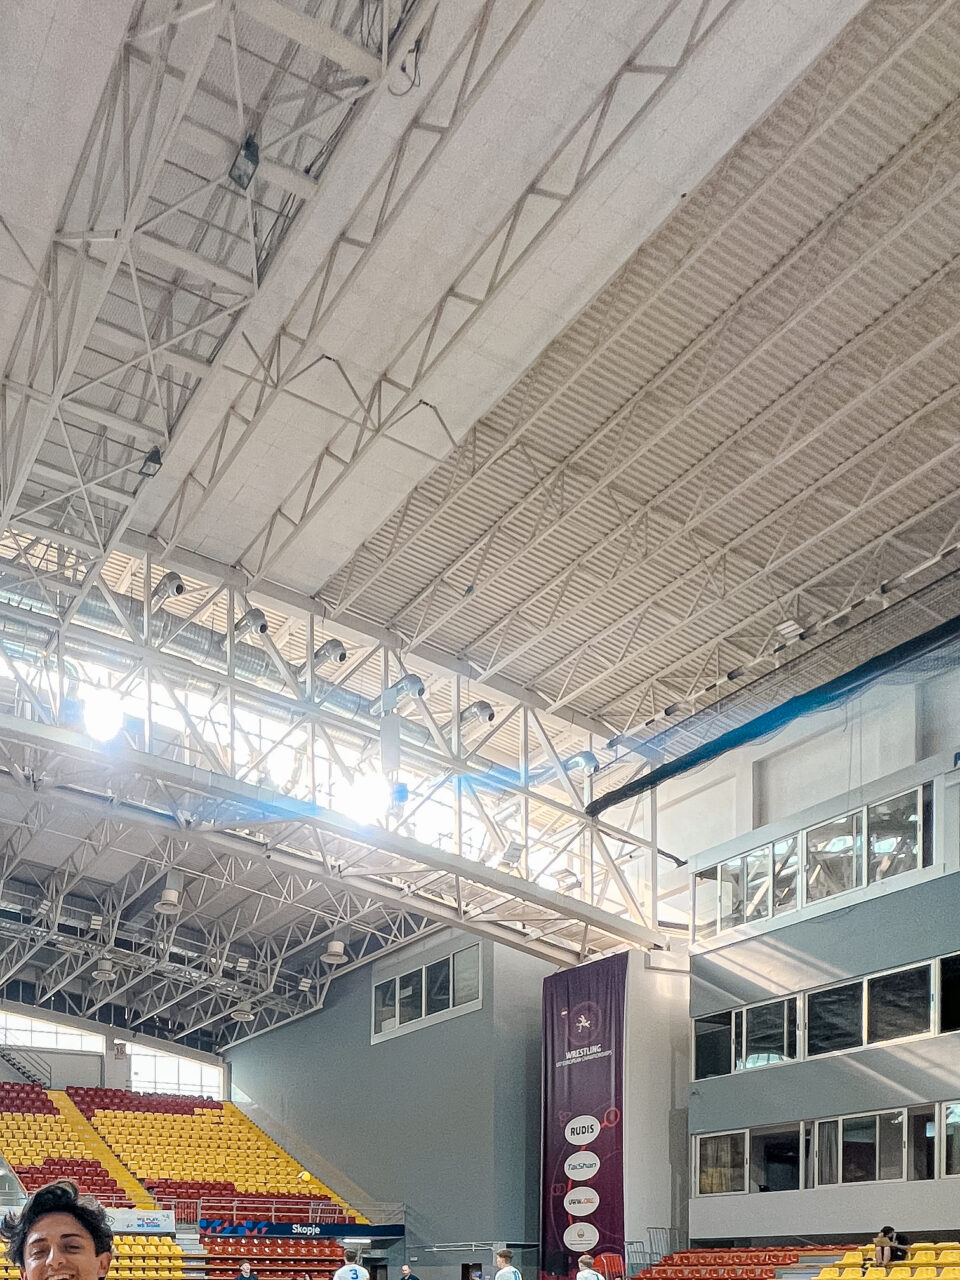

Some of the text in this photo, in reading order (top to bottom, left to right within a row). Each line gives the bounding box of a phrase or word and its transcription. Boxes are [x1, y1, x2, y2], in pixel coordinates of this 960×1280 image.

[565, 1044, 602, 1059] WRESTLING
[570, 1124, 595, 1137] RUDIS
[291, 1223, 321, 1236] Skopje
[349, 1268, 359, 1280] 3
